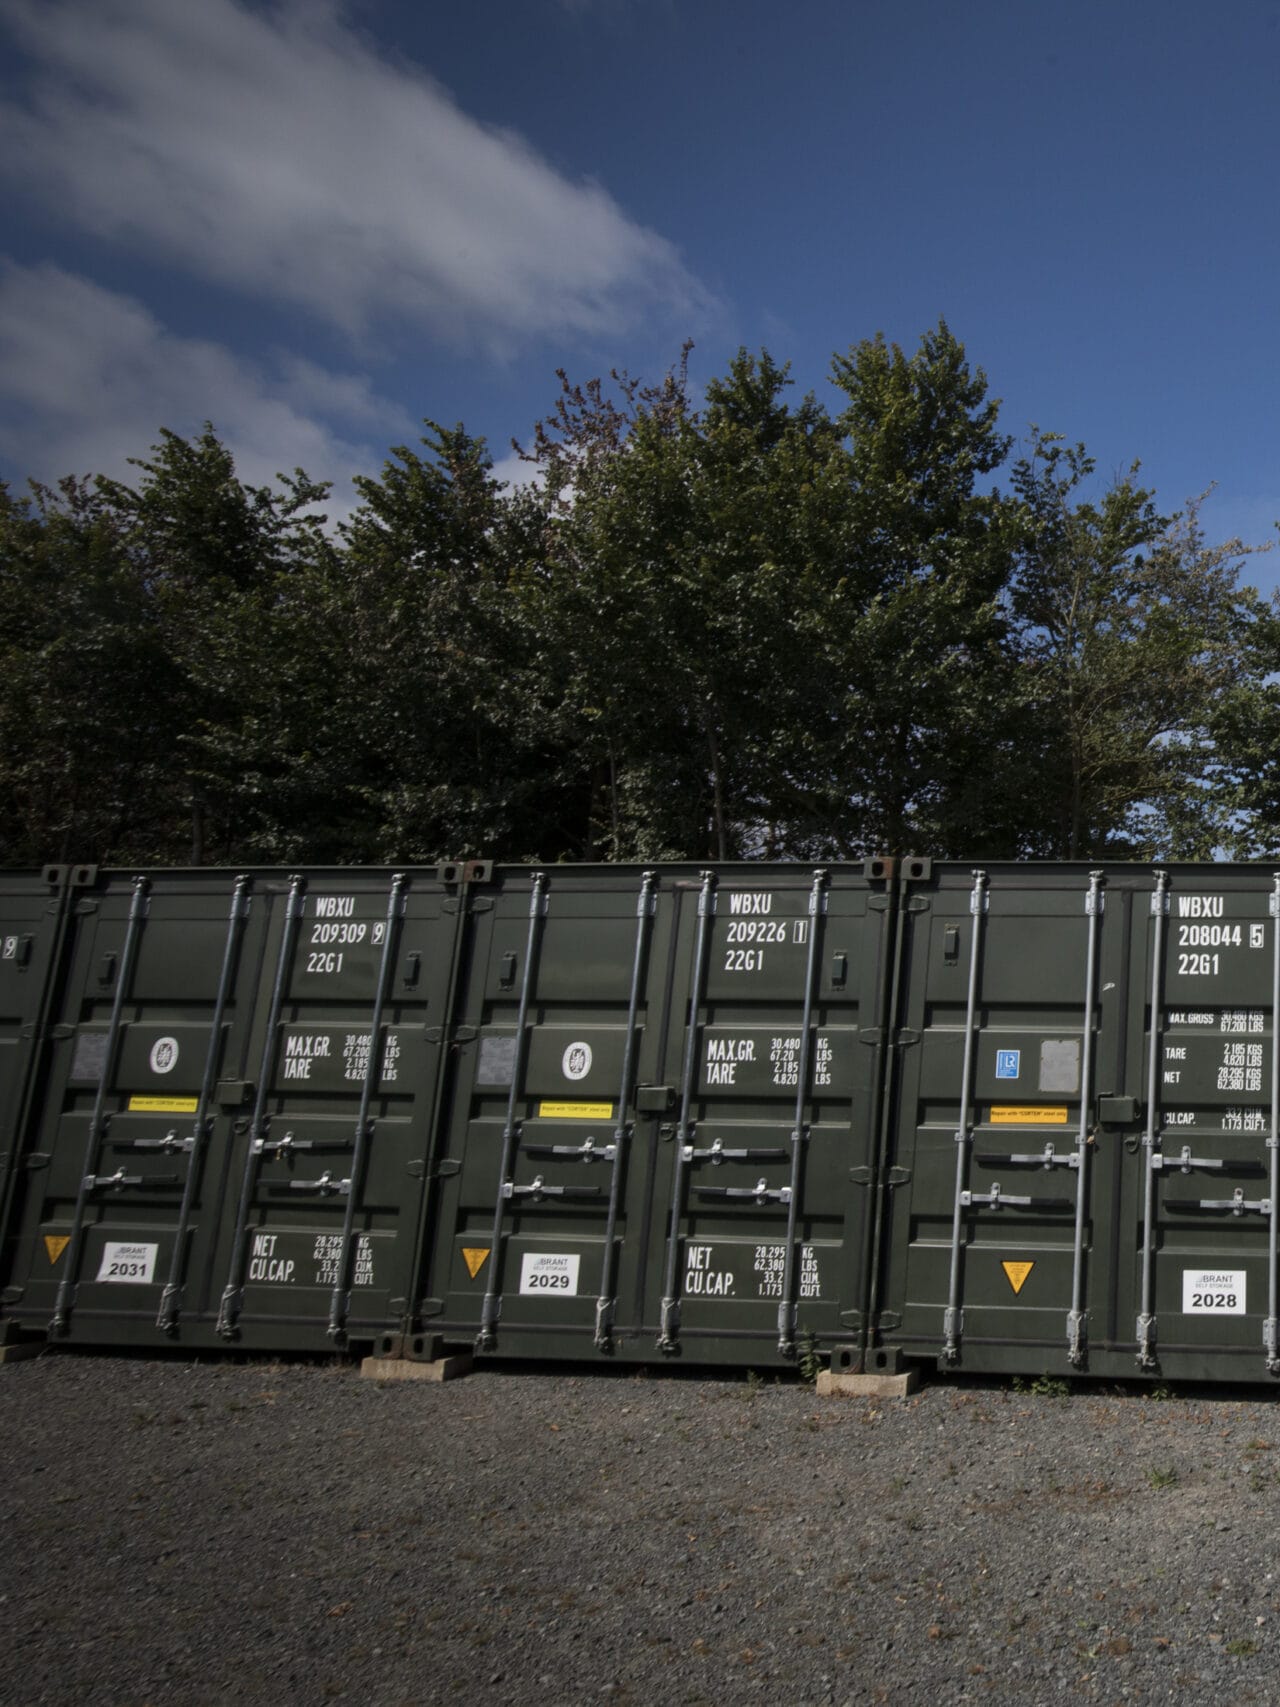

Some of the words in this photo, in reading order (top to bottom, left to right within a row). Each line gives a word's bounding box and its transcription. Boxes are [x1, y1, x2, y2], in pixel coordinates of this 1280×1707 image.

[316, 897, 355, 917] WBXU
[730, 893, 772, 914] WBXU
[1178, 896, 1224, 917] WBXU
[311, 923, 367, 943] 209309
[372, 923, 385, 944] 9
[726, 921, 787, 943] 209226
[1178, 925, 1242, 946] 208044
[1251, 925, 1263, 947] 5
[4, 937, 17, 958] 9
[307, 952, 344, 973] 22G1
[724, 949, 764, 971] 22G1
[1178, 953, 1219, 975] 22G1
[1248, 1021, 1264, 1032] LBS
[286, 1036, 331, 1057] MAX.GR.
[386, 1036, 398, 1047] KG
[817, 1038, 828, 1050] KG
[385, 1047, 400, 1058] LBS
[707, 1039, 757, 1061] MAX.GR.
[816, 1049, 833, 1061] LBS
[1165, 1047, 1187, 1060] TARE
[1247, 1044, 1263, 1055] KGS
[383, 1058, 394, 1069] KG
[815, 1061, 827, 1073] KG
[1246, 1055, 1262, 1067] LBS
[284, 1058, 313, 1079] TARE
[382, 1069, 397, 1080] LBS
[706, 1063, 737, 1084] TARE
[1245, 1068, 1262, 1079] KGS
[815, 1073, 831, 1085] LBS
[1164, 1071, 1181, 1083] NET
[1245, 1079, 1261, 1091] LBS
[252, 1235, 278, 1257] NET
[358, 1237, 370, 1248] KG
[356, 1248, 373, 1260] LBS
[687, 1246, 712, 1270] NET
[802, 1247, 814, 1259] KG
[109, 1262, 147, 1277] 2031
[249, 1258, 296, 1282] CU.CAP.
[801, 1259, 818, 1271] LBS
[528, 1274, 570, 1288] 2029
[685, 1271, 736, 1295] CU.CAP.
[1192, 1293, 1237, 1307] 2028
